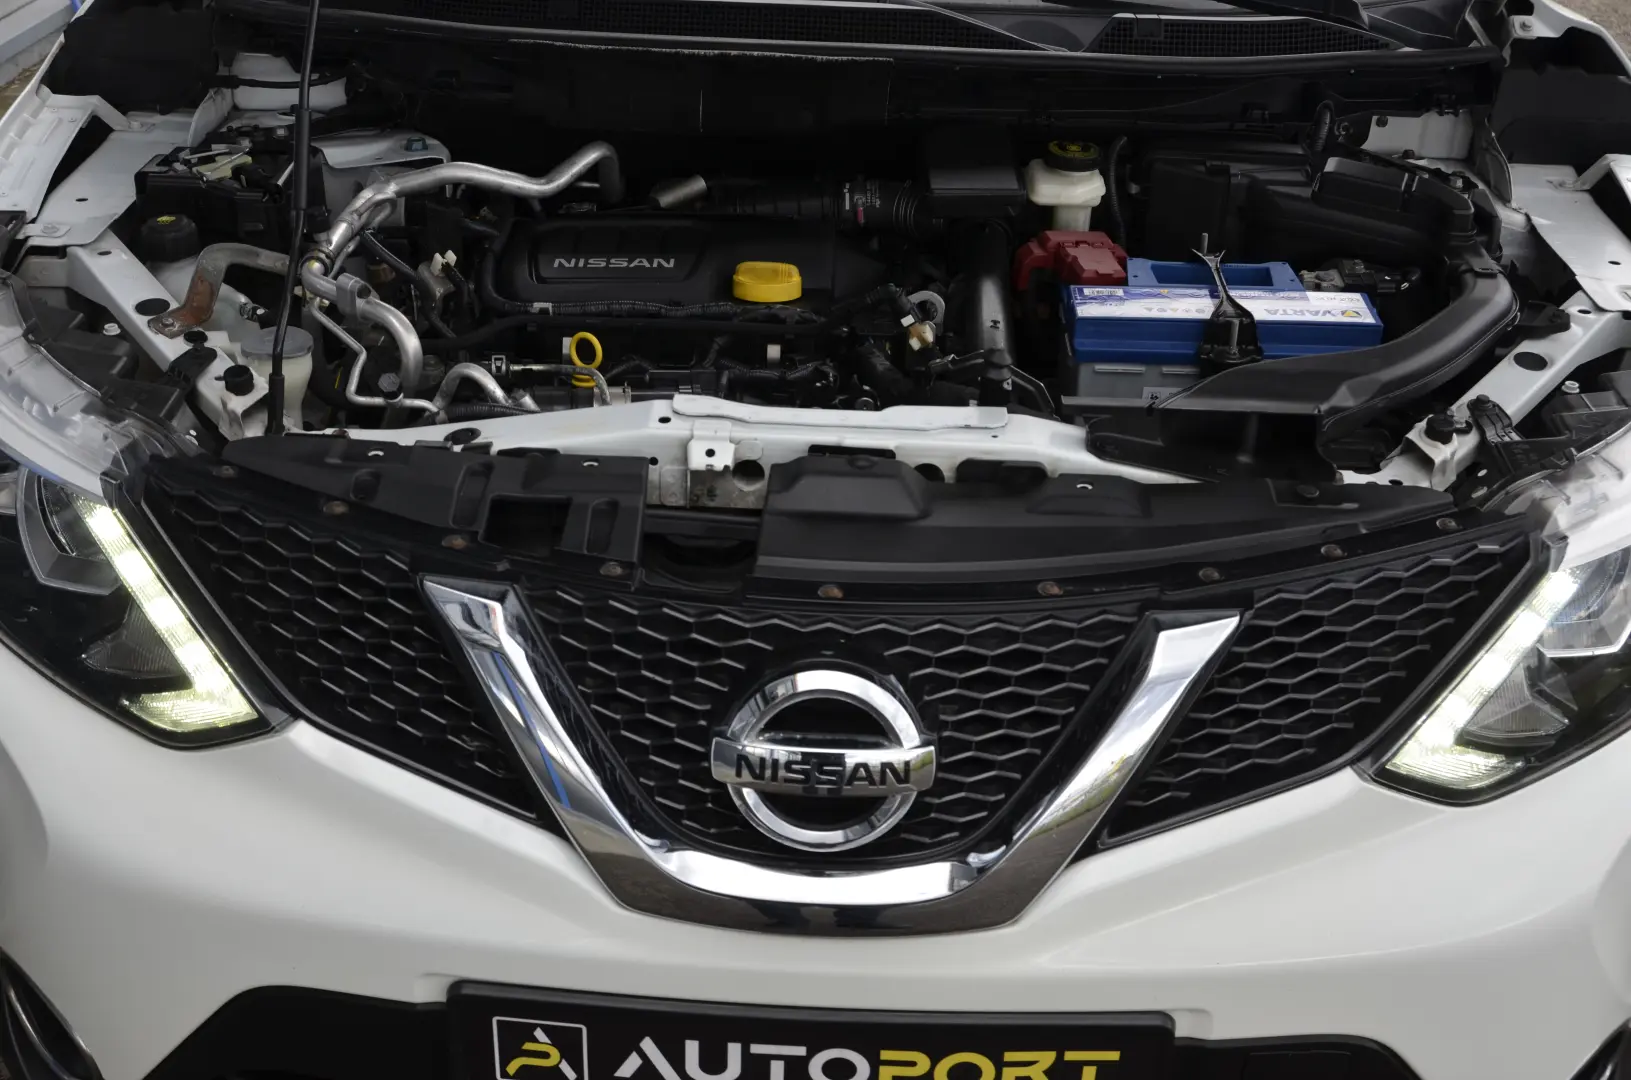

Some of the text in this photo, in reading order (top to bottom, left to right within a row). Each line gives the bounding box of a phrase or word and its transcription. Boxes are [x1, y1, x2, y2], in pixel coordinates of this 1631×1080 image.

[553, 257, 675, 268] NISSAN
[1264, 308, 1336, 318] VARTA
[735, 754, 911, 786] NISSAN
[614, 1036, 1121, 1080] AUTOPORT
